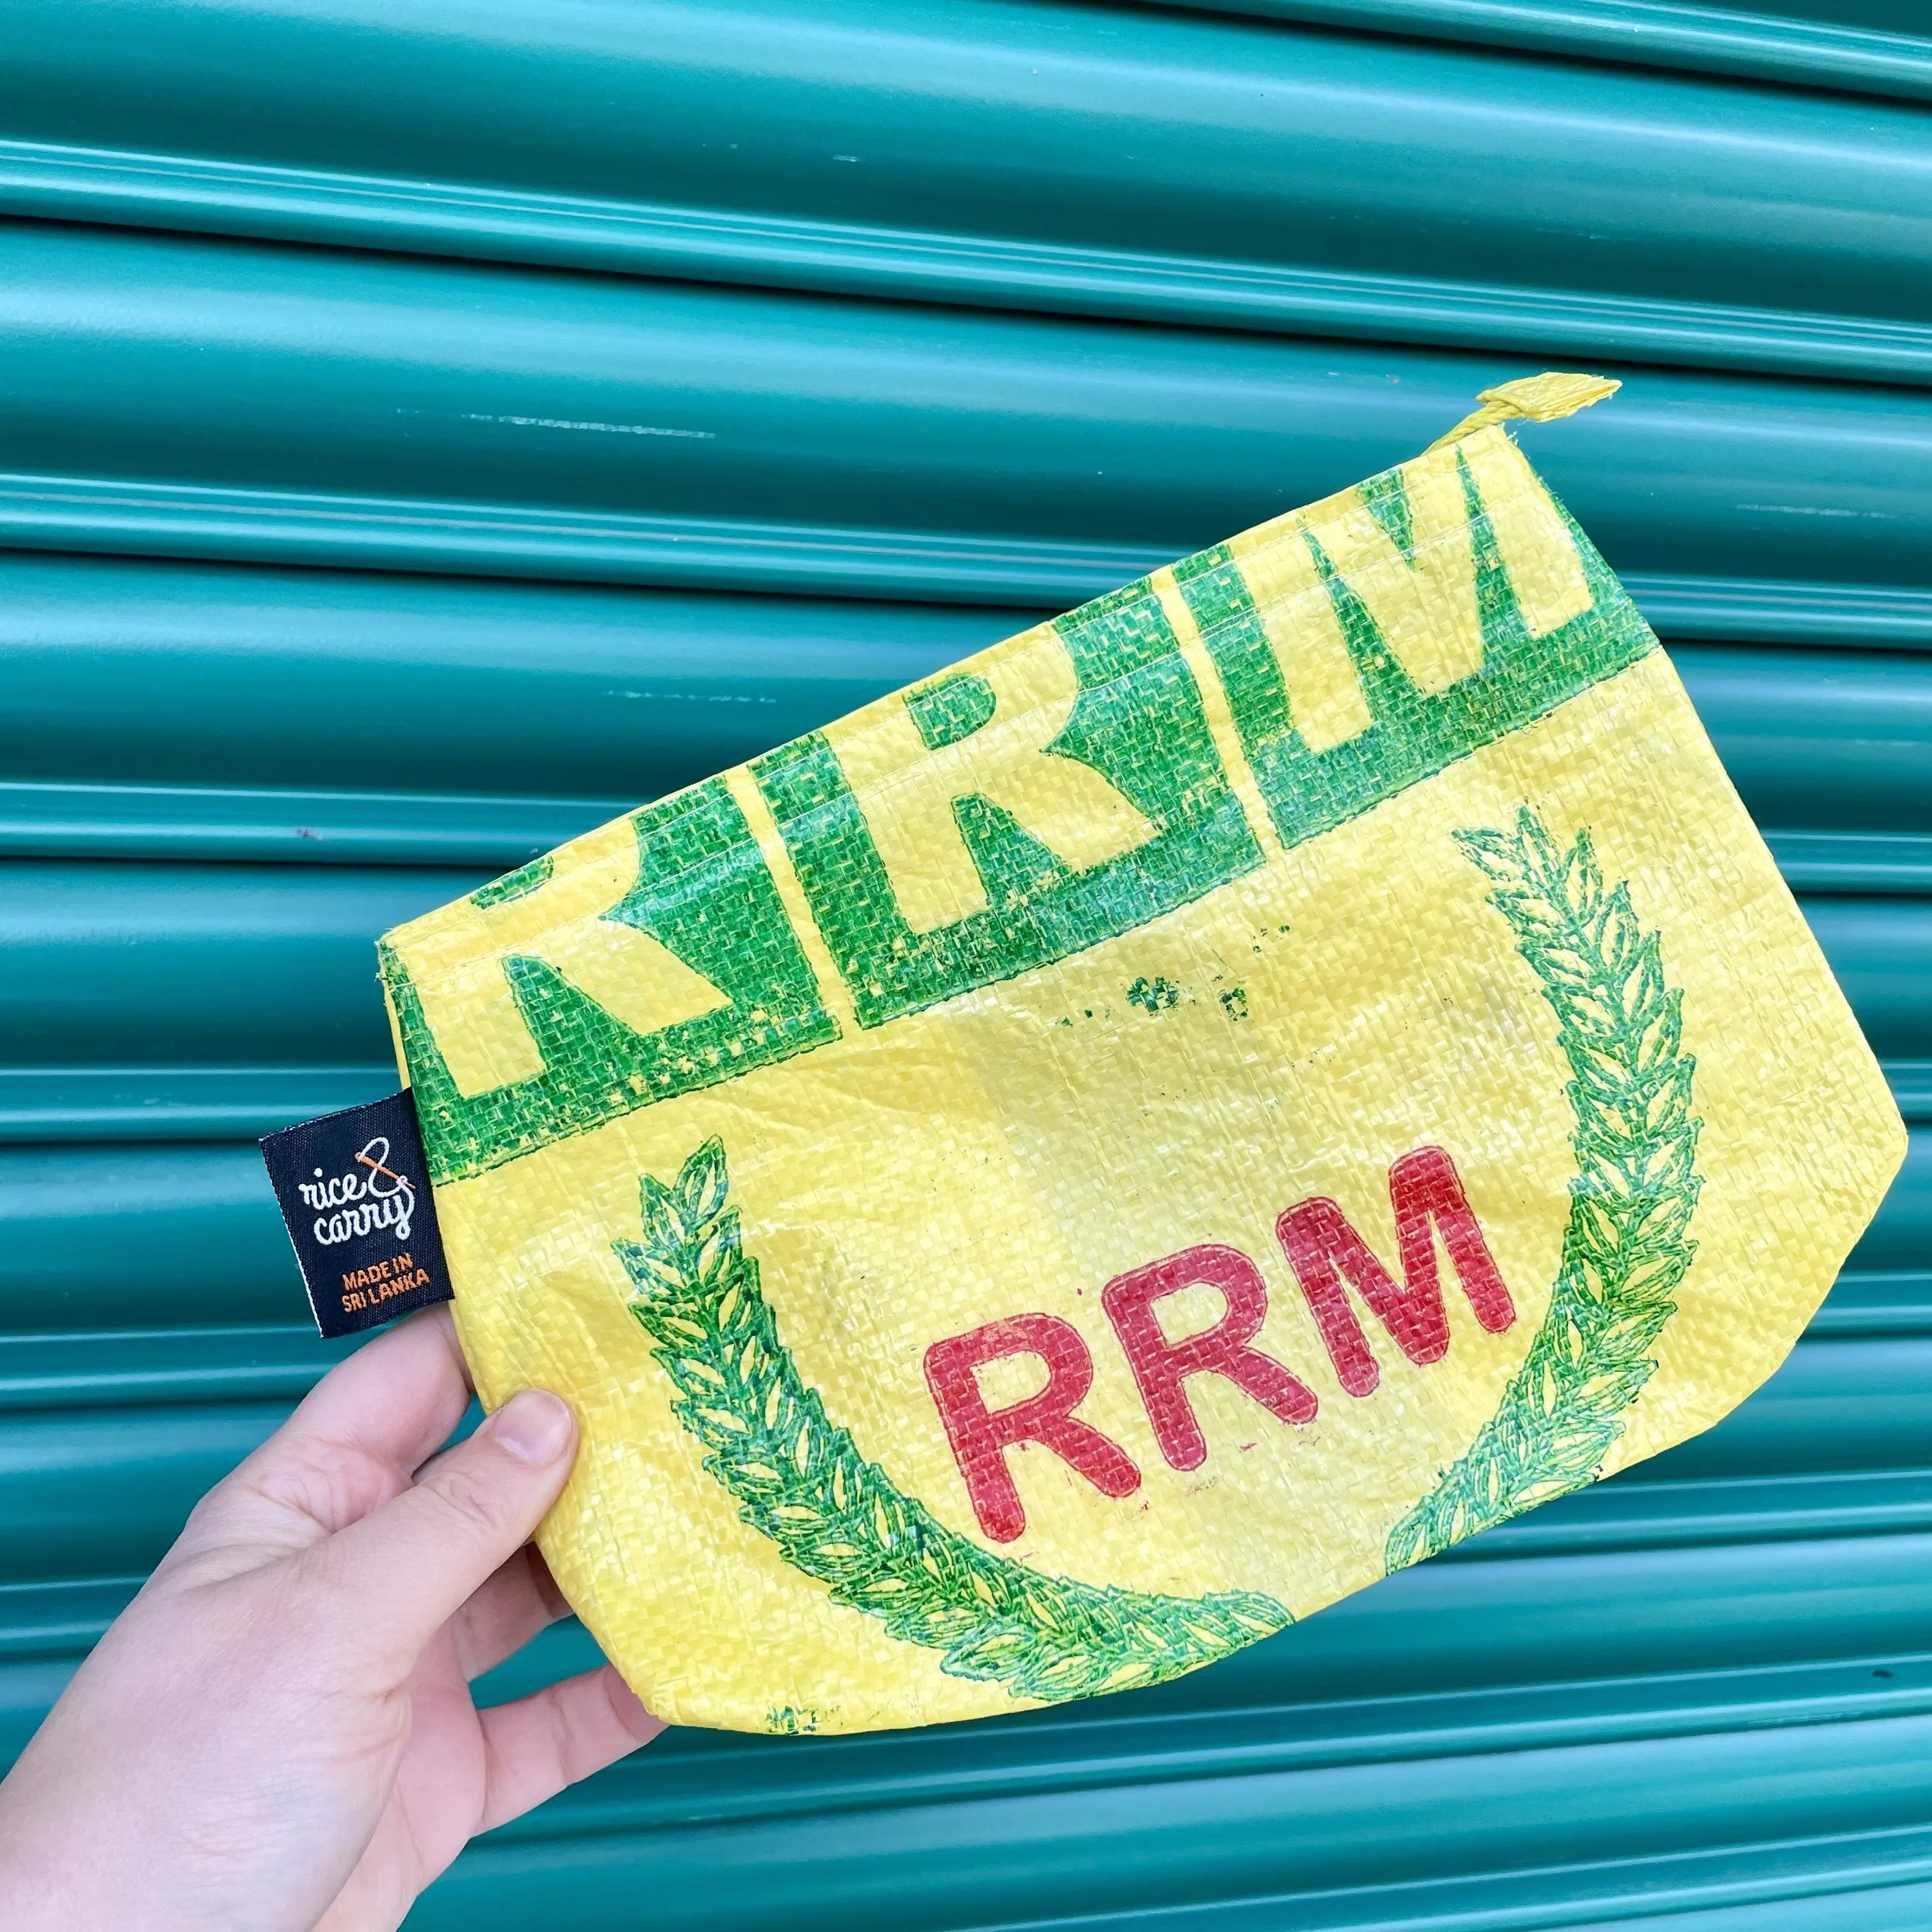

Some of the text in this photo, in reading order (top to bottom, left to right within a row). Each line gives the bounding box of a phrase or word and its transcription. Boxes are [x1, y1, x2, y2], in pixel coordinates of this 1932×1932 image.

[298, 1168, 368, 1210] rice
[313, 1190, 416, 1246] carry
[342, 1252, 413, 1291] MADE IN
[342, 1268, 430, 1313] SRI LANKA
[923, 1144, 1517, 1543] RRM
